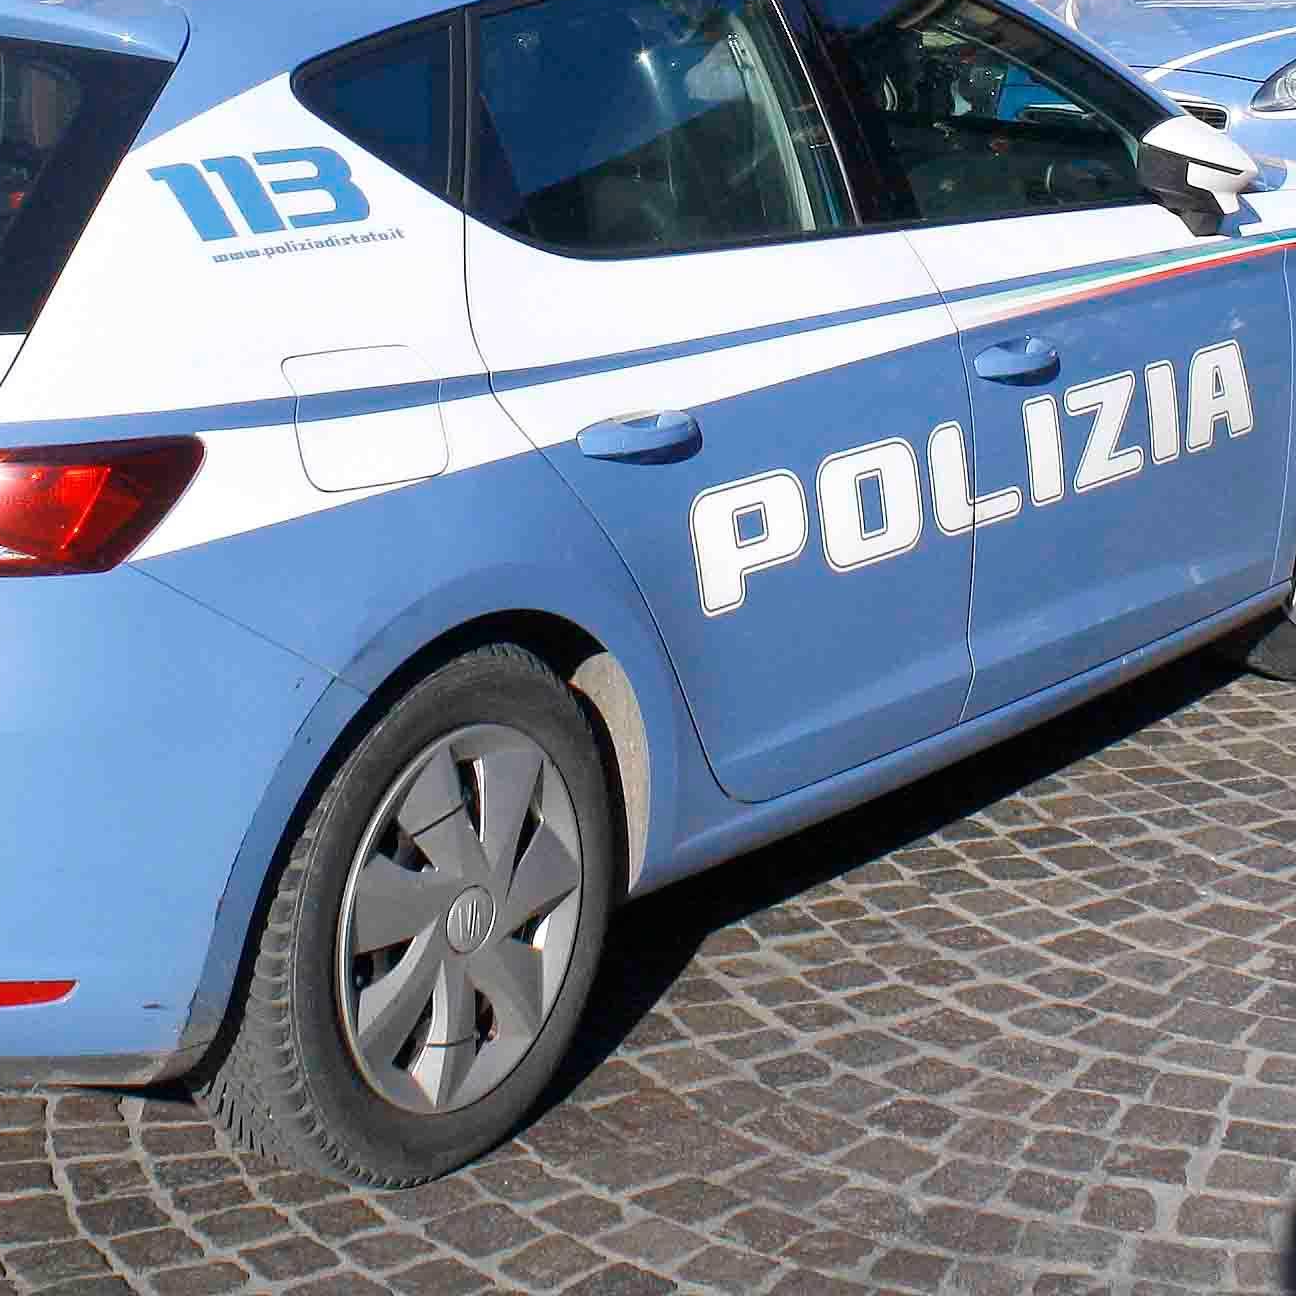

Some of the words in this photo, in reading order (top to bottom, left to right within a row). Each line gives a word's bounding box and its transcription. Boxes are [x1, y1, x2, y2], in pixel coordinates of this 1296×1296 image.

[146, 146, 370, 241] 113
[212, 227, 406, 263] www.poliziadistato.it
[688, 339, 1254, 618] POLIZIA
